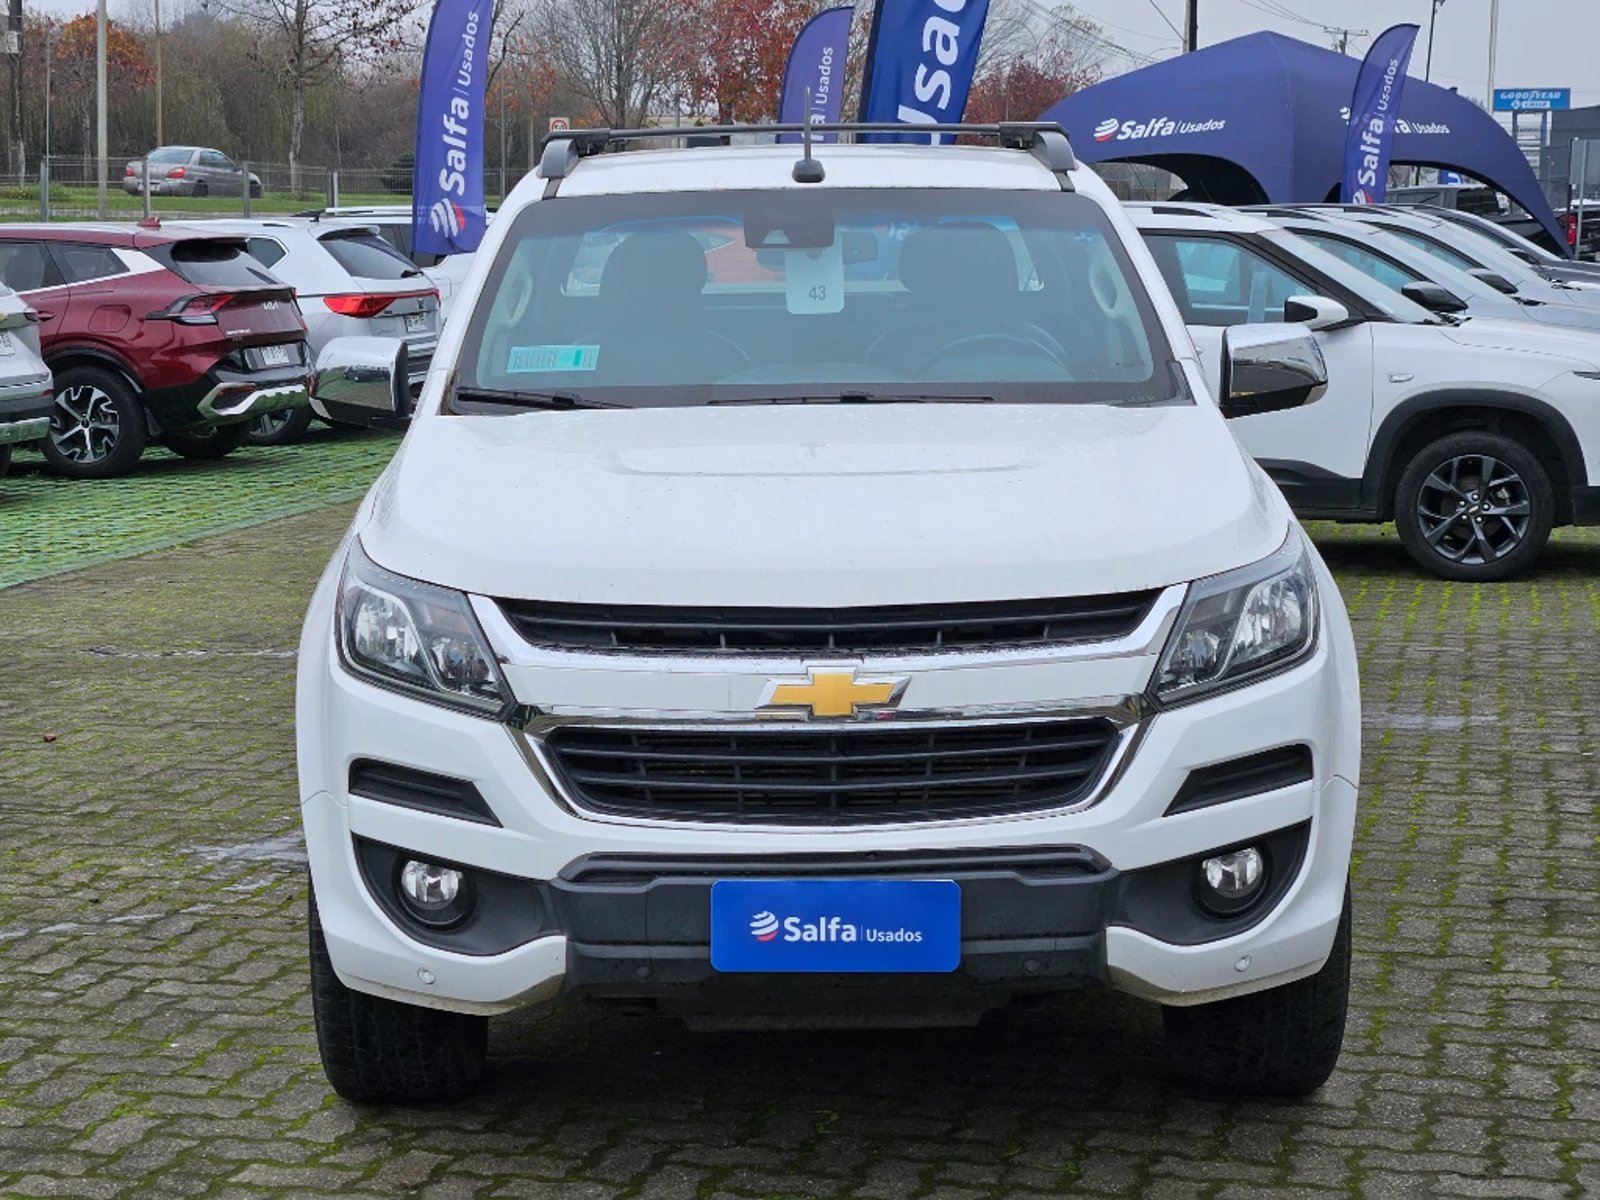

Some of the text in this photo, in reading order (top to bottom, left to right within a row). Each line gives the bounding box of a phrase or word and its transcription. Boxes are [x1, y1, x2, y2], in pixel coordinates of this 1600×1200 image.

[815, 47, 834, 104] Usados
[439, 11, 479, 196] Salfa Usados
[1357, 58, 1398, 187] Salfa Usados
[1116, 116, 1226, 141] Salfa Usados
[809, 285, 826, 301] 43
[783, 916, 923, 943] Salfa Usados
